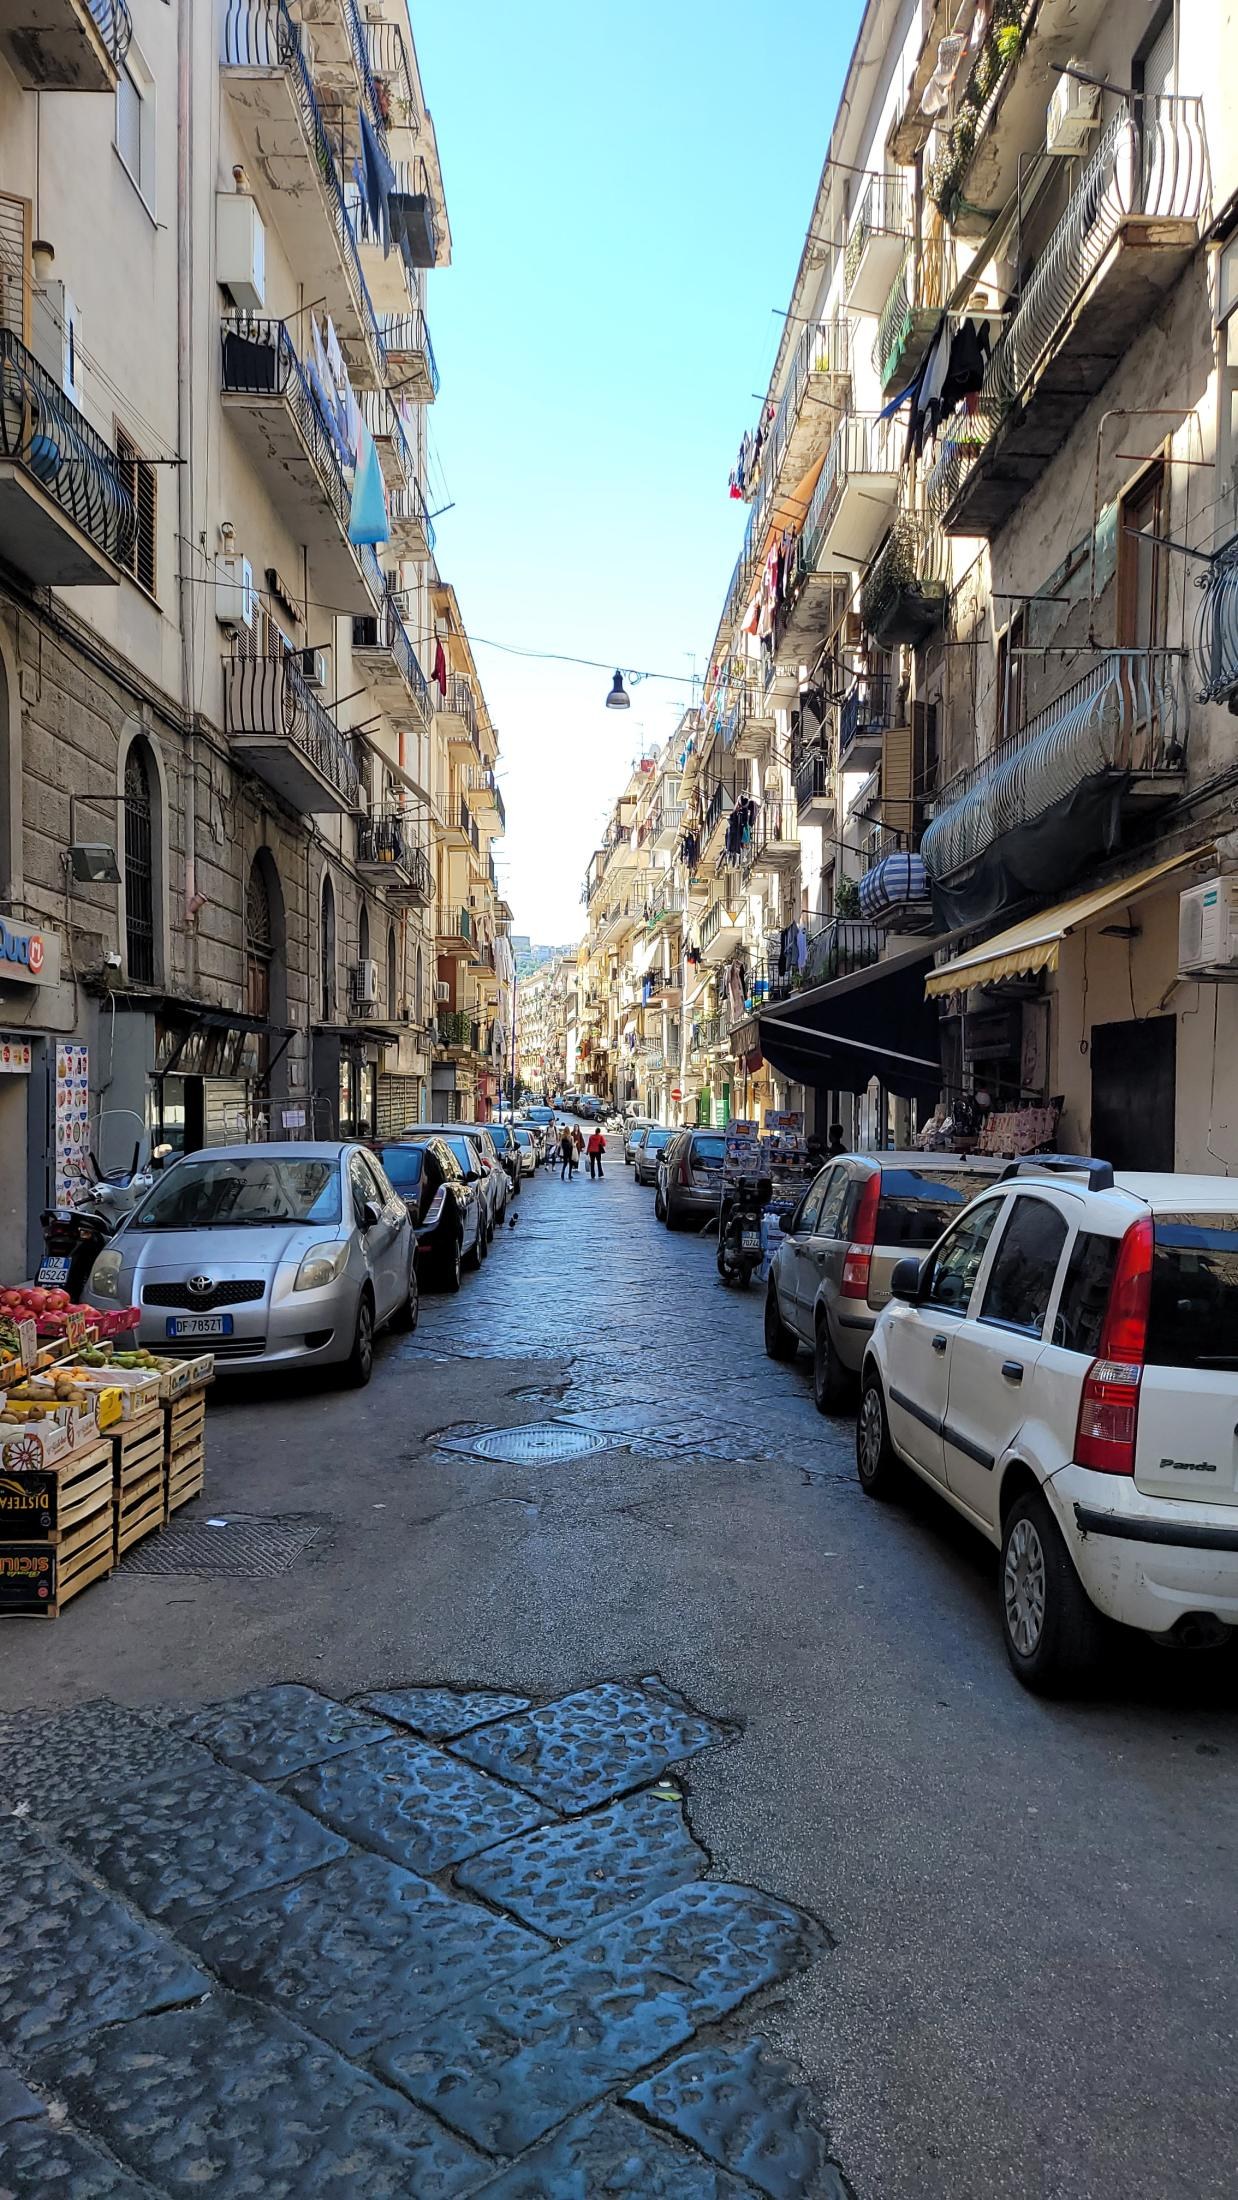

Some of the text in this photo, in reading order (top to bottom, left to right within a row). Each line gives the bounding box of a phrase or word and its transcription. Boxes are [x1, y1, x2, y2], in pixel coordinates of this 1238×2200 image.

[40, 1270, 66, 1280] 05243
[176, 1320, 188, 1332] DF
[191, 1319, 222, 1332] 783ZT
[1159, 1458, 1216, 1471] Panda
